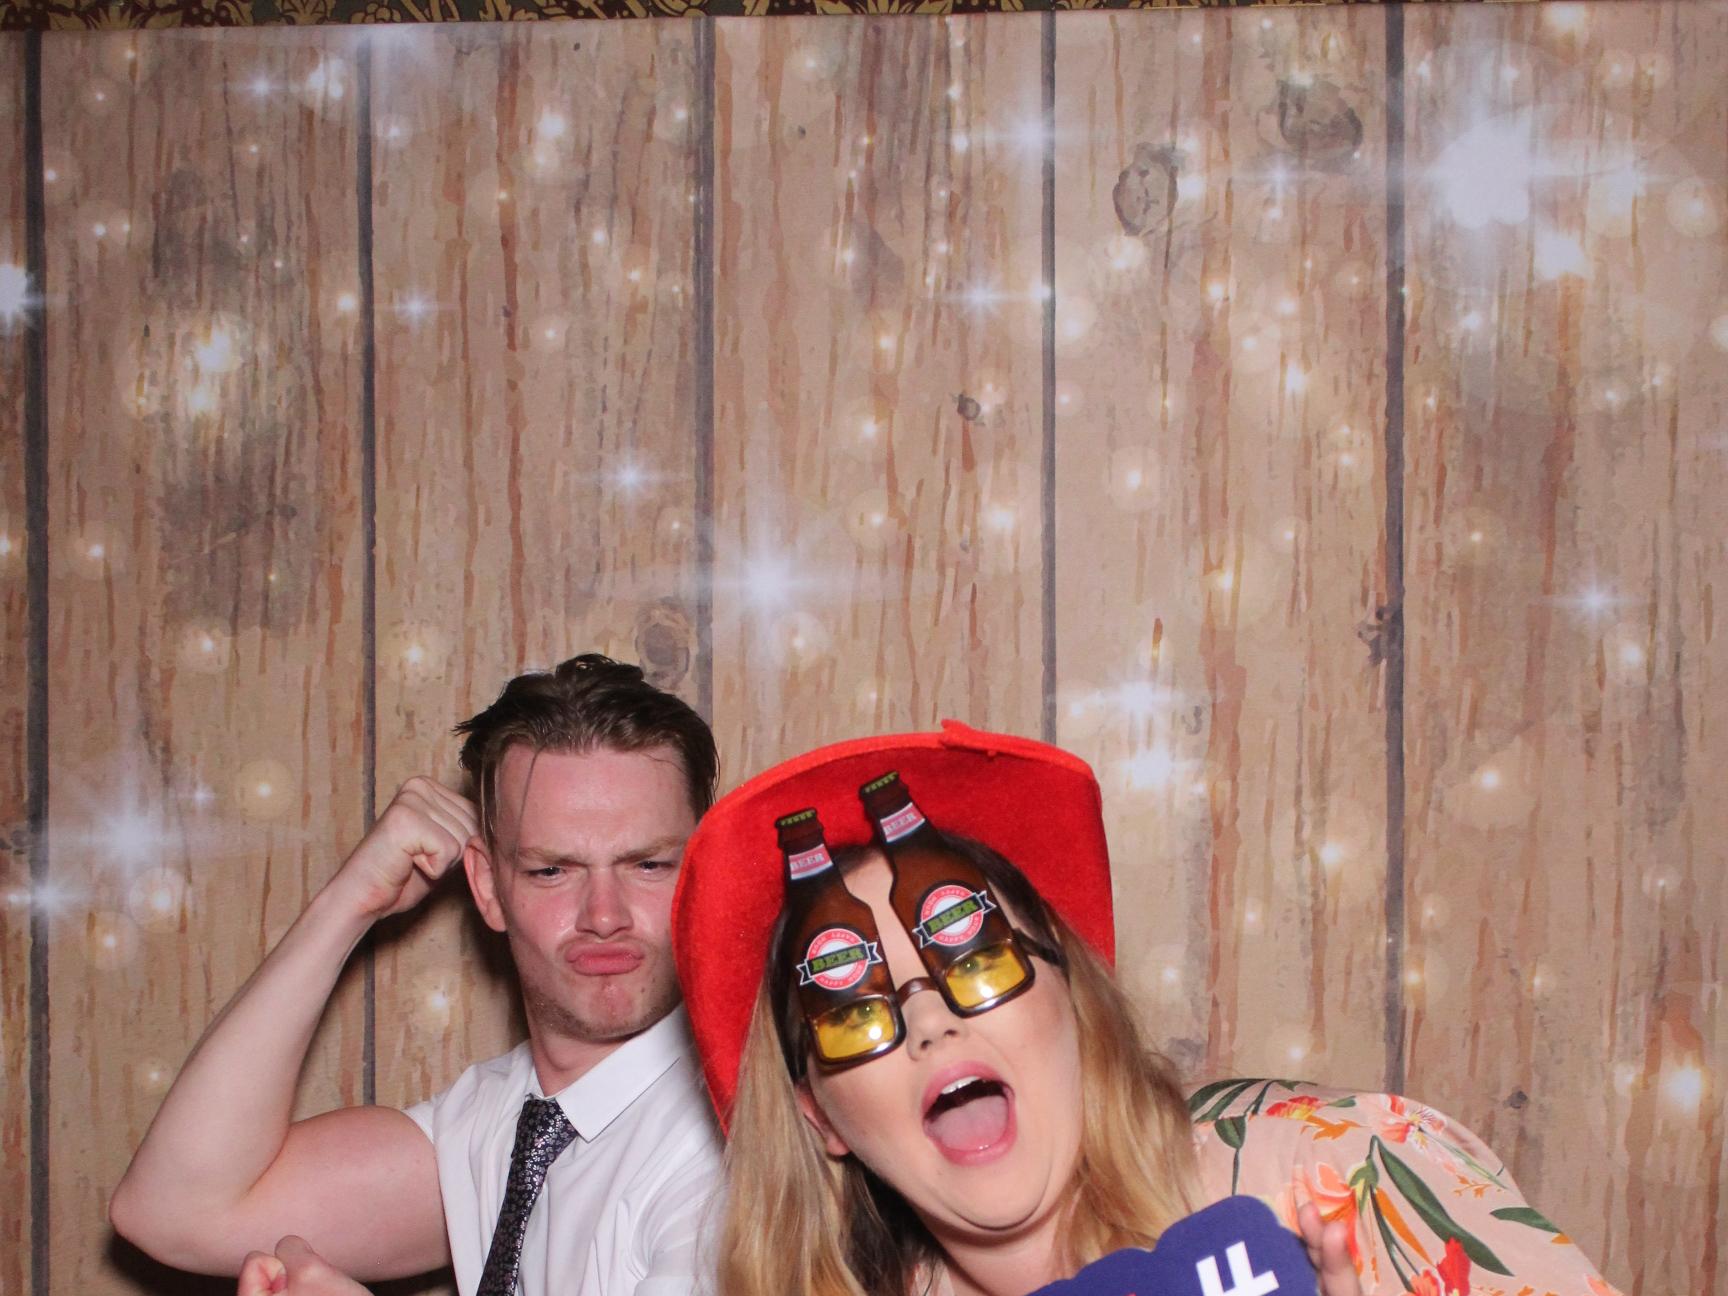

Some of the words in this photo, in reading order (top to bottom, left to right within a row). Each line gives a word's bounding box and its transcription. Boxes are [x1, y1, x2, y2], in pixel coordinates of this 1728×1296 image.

[790, 852, 824, 870] BEER
[927, 899, 978, 933] BEER
[811, 947, 864, 972] BEER
